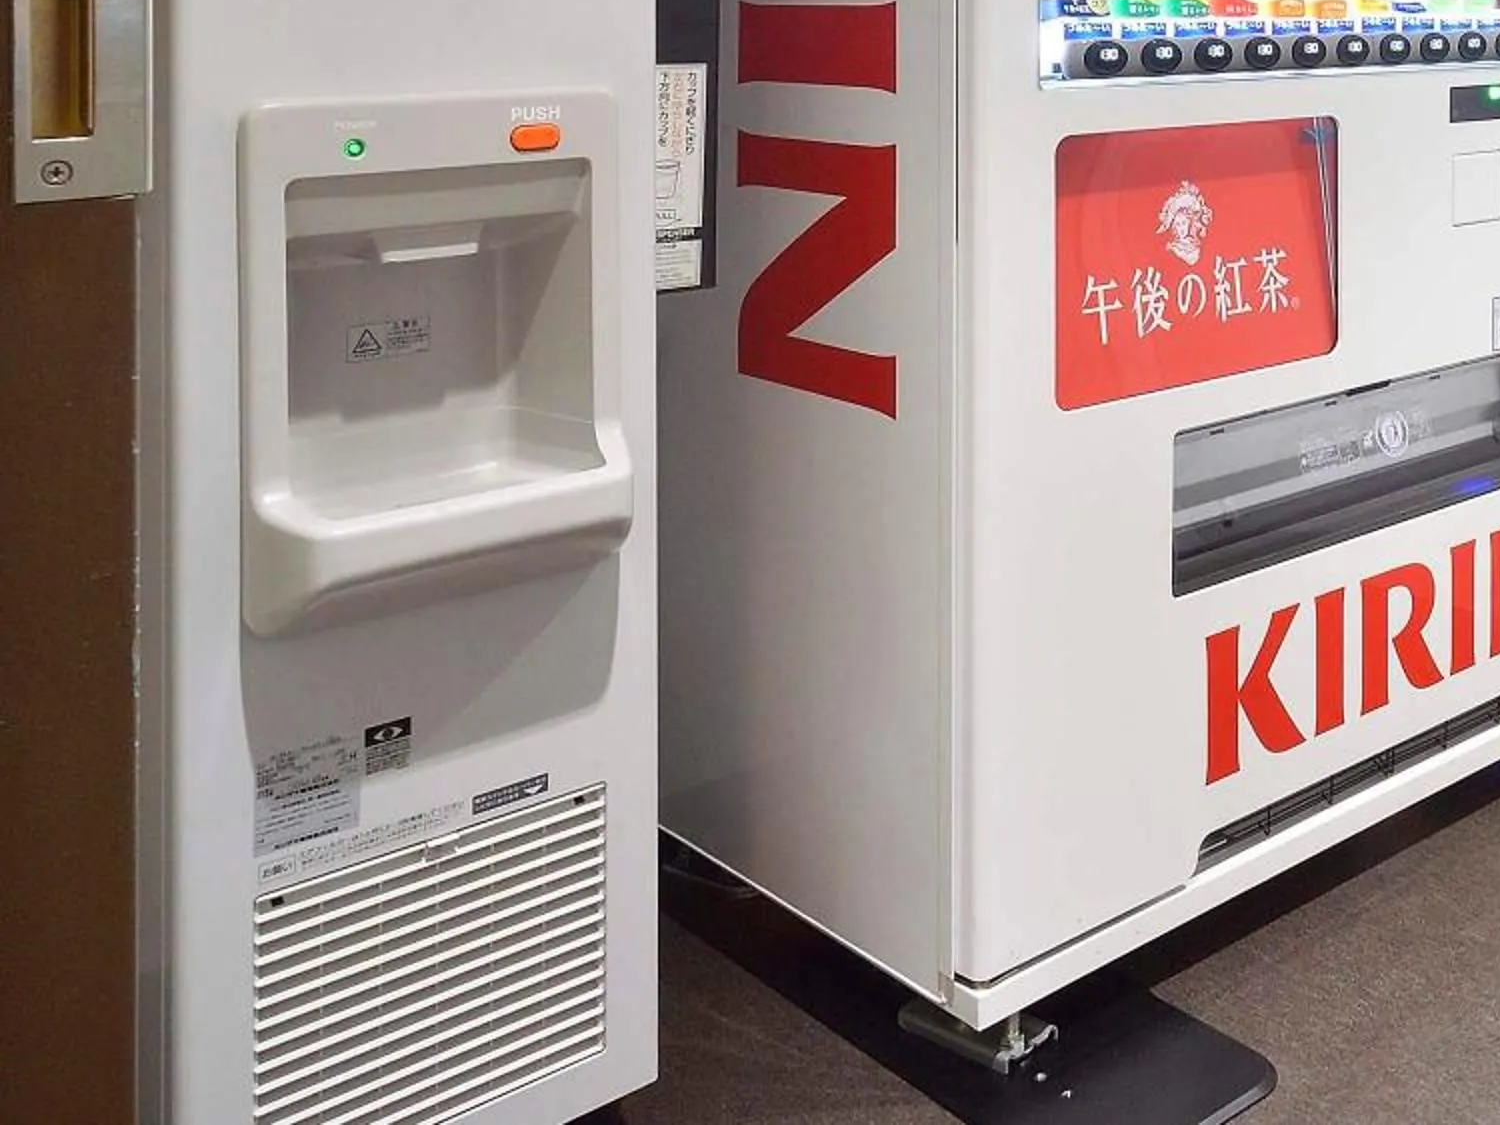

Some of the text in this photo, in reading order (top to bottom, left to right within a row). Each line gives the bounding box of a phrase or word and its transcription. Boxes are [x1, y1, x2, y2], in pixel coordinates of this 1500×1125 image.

[510, 105, 561, 122] PUSH
[1081, 247, 1290, 345] 午後の紅茶
